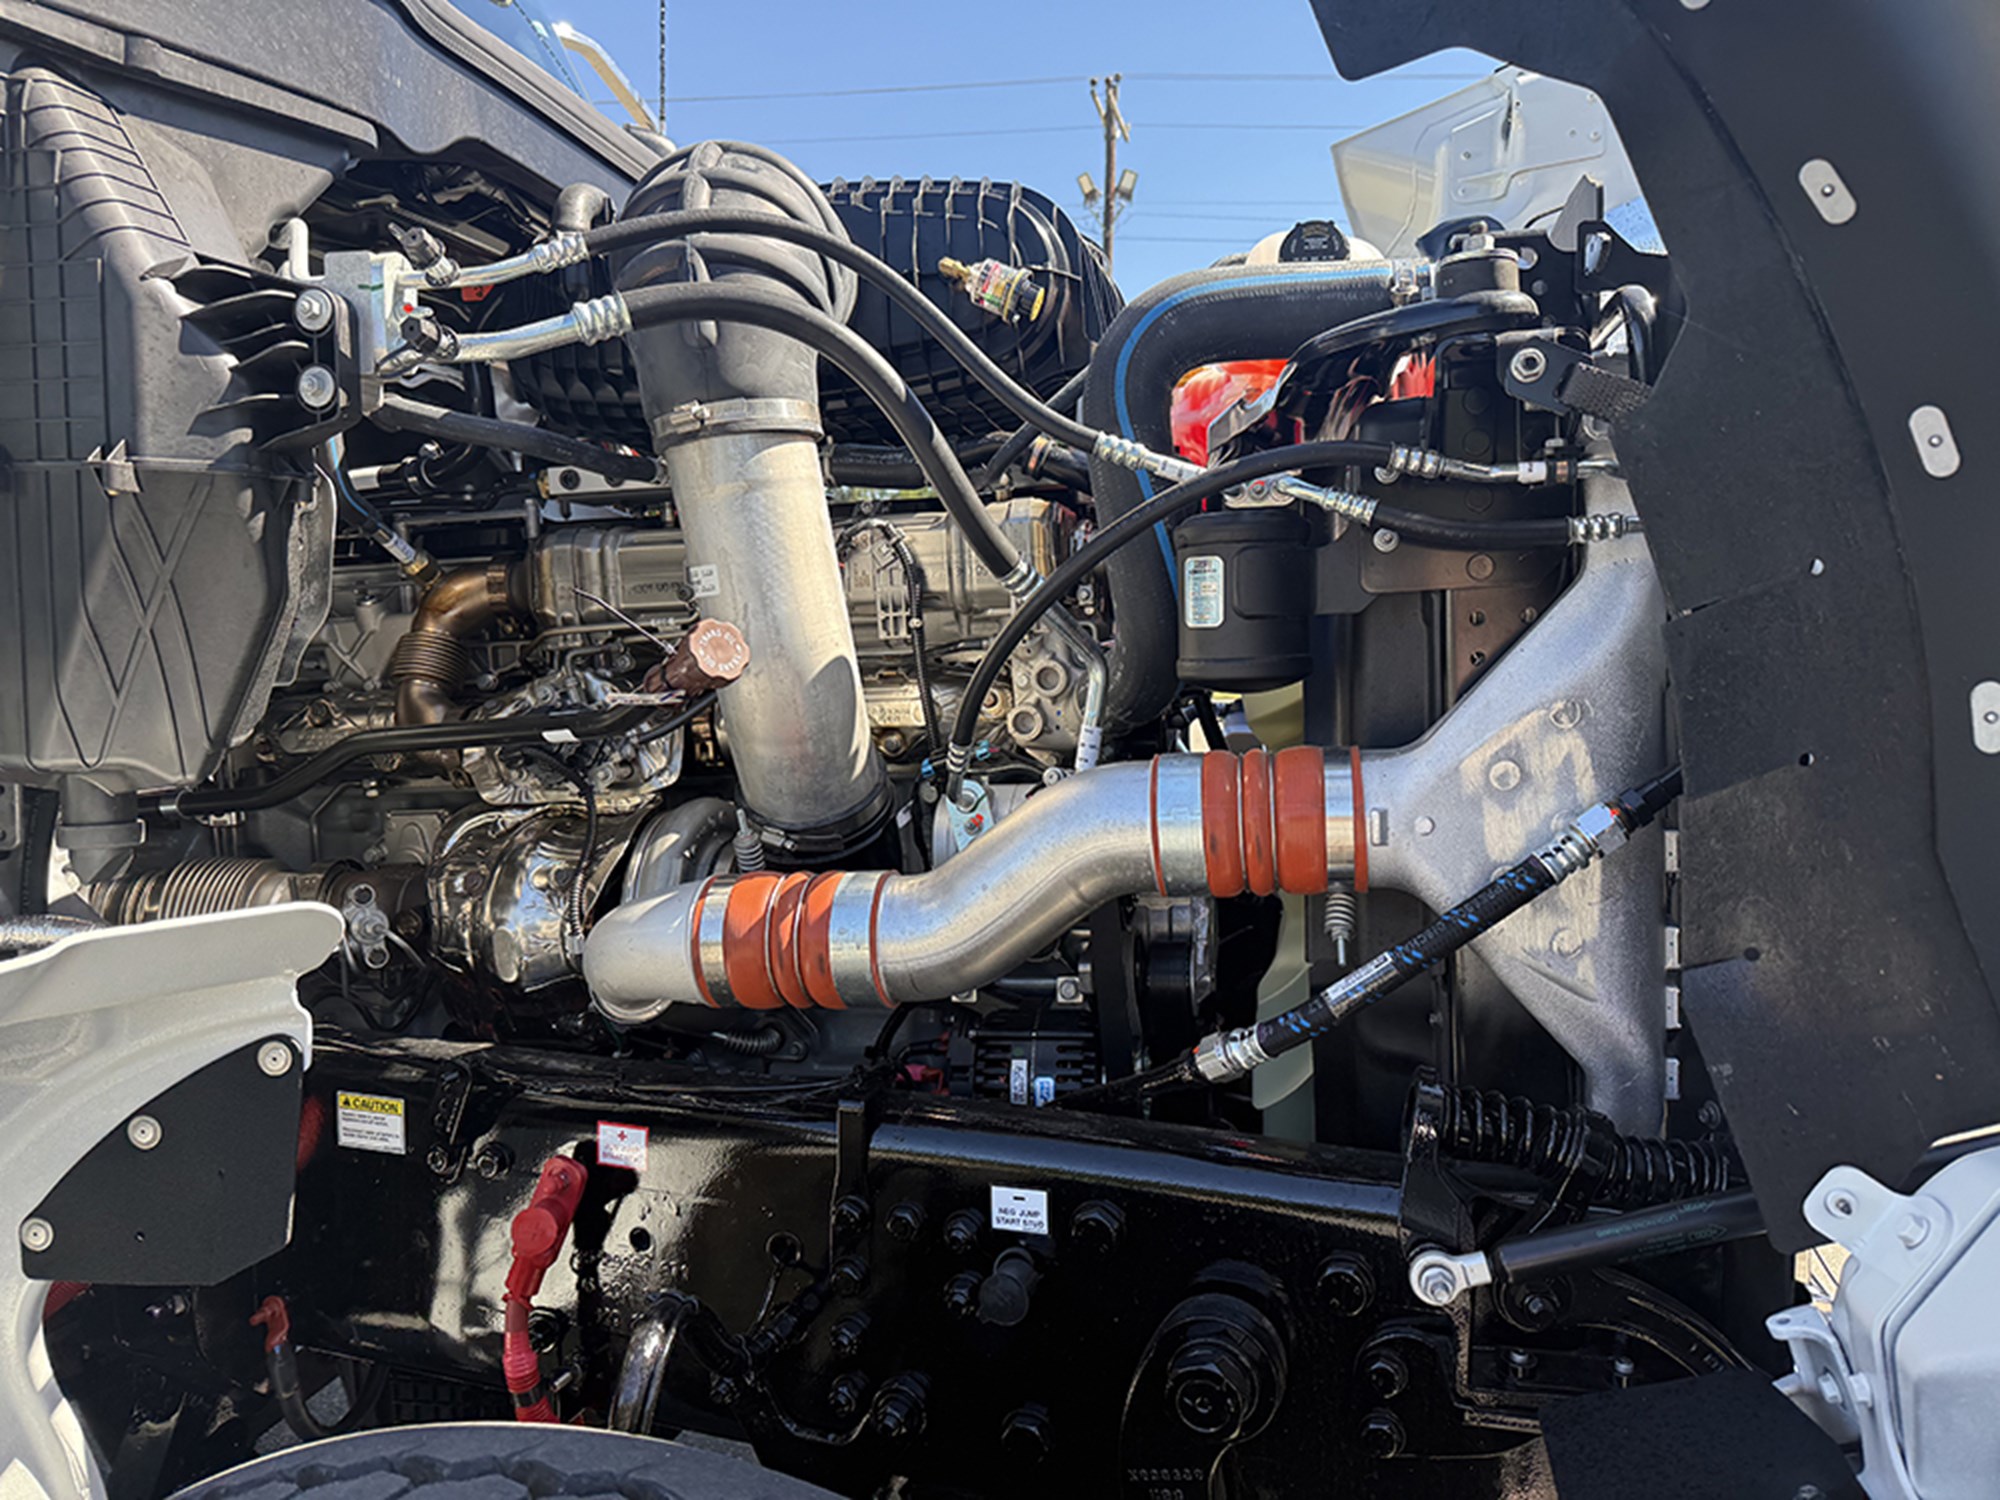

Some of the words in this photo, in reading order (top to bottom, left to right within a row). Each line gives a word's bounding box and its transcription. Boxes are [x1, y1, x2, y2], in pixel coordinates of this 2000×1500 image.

[698, 628, 722, 646] TRANS
[724, 631, 736, 645] OIL
[352, 1097, 399, 1113] CAUTION
[998, 1207, 1016, 1216] NEG
[1019, 1210, 1041, 1218] JUMP
[996, 1216, 1020, 1225] START
[1022, 1219, 1045, 1229] STUD
